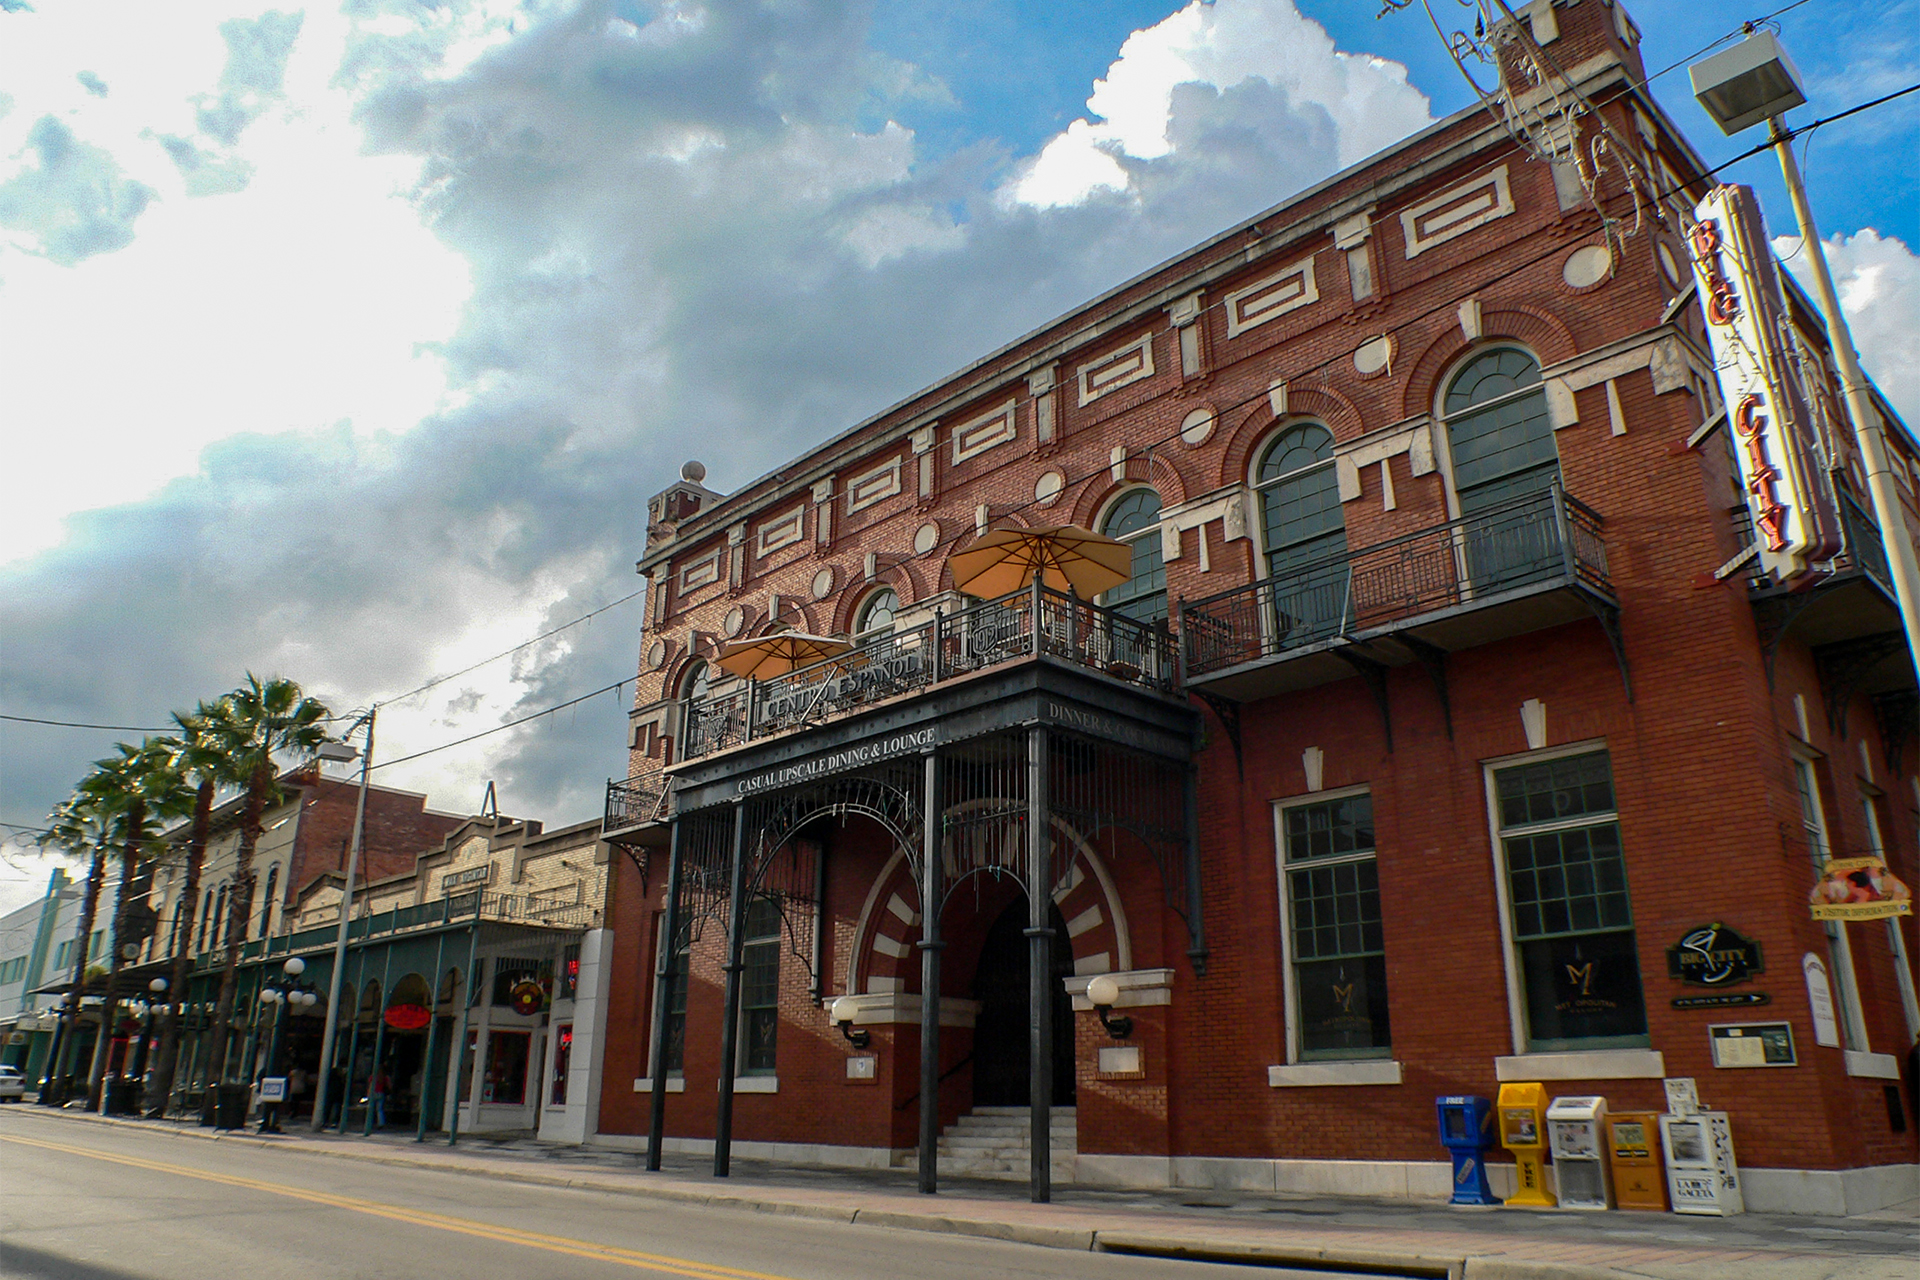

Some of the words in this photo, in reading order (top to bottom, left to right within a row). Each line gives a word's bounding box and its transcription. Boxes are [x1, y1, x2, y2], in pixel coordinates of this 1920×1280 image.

[1694, 218, 1740, 326] BIG
[1737, 394, 1789, 552] CITY
[975, 628, 996, 651] 1912
[766, 684, 829, 718] CENTRO
[1049, 703, 1100, 730] DINNER
[1103, 720, 1113, 734] &
[738, 775, 777, 793] CASUAL
[779, 758, 826, 783] UPSCALE
[828, 747, 868, 770] DINING
[870, 743, 880, 758] &
[883, 728, 935, 755] LOUNGE
[1679, 952, 1705, 964] BIG
[1710, 949, 1746, 962] CITY
[1445, 1096, 1465, 1105] FREE
[1523, 1161, 1534, 1188] FREE
[1676, 1180, 1691, 1189] LA
[1677, 1190, 1714, 1199] GACETA
